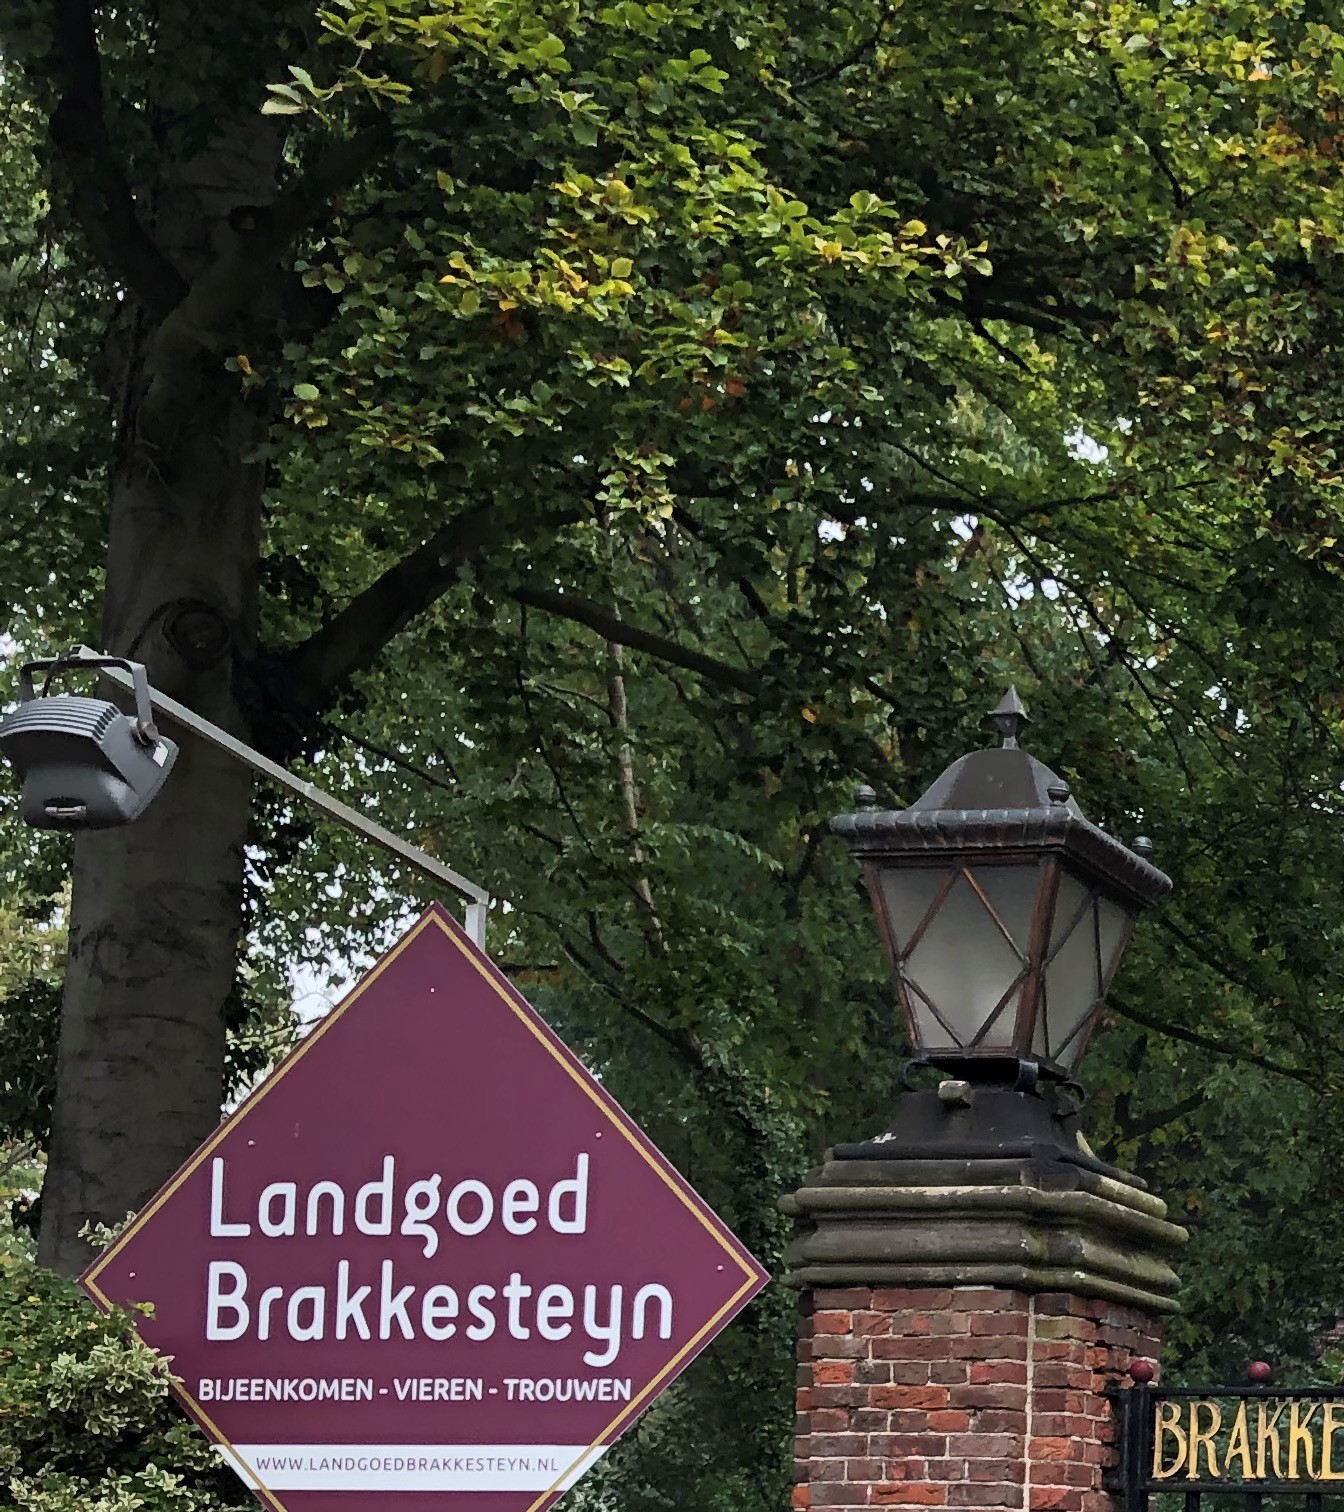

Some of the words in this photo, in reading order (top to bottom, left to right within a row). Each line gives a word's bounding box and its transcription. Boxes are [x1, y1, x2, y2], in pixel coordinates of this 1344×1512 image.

[210, 1153, 589, 1258] Landgoed
[206, 1259, 673, 1367] Brakkesteyn
[199, 1378, 373, 1401] BIJEENKOMEN
[394, 1378, 483, 1401] VIEREN
[503, 1378, 632, 1401] TROUWEN
[256, 1457, 560, 1472] WWW.LANDGOEDBRAKKESTEYN.NL
